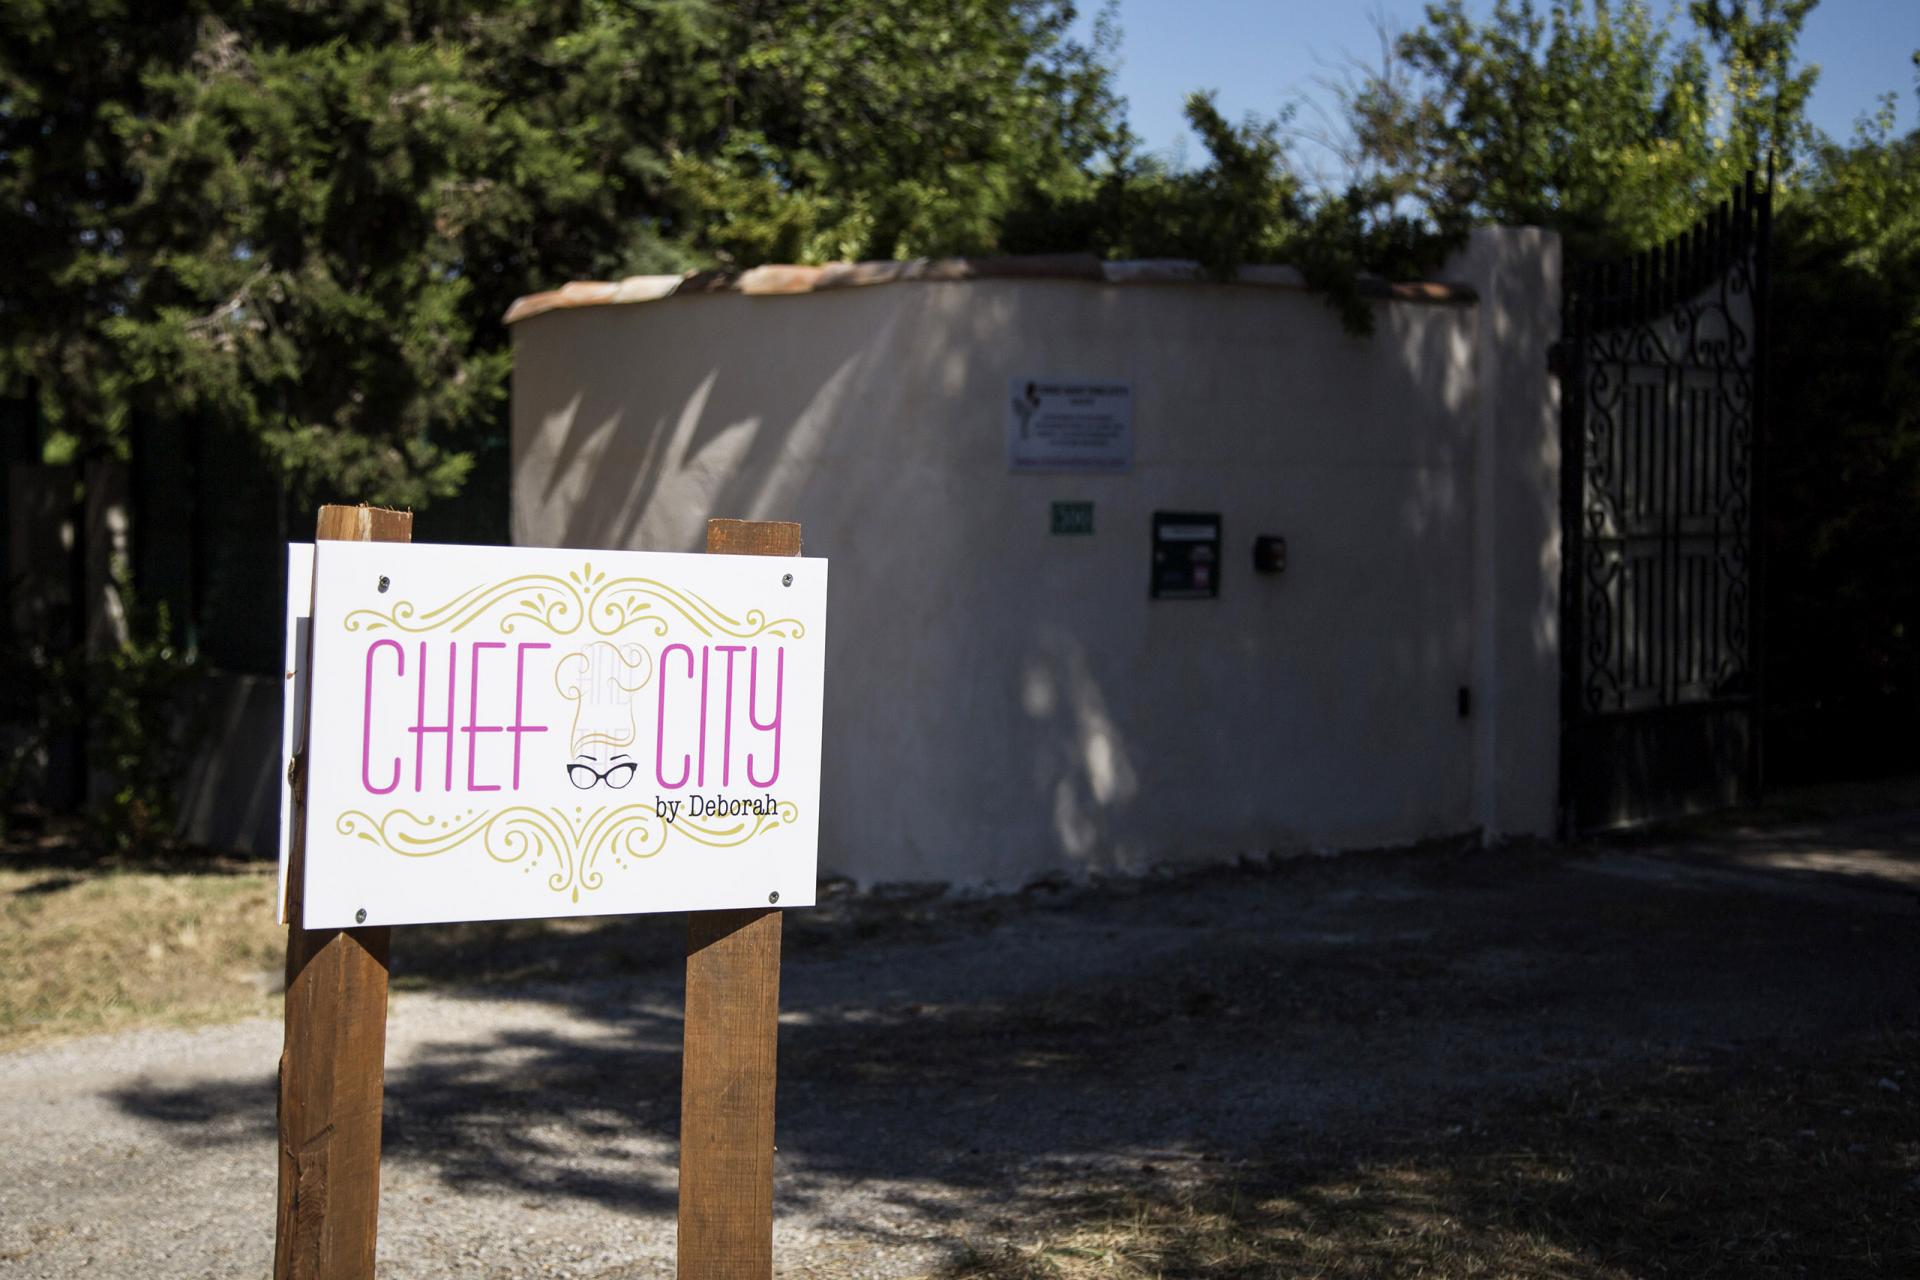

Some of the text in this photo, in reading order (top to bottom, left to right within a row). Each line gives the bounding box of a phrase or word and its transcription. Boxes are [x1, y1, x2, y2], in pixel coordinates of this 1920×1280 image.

[362, 639, 784, 794] CHEF CITY
[655, 793, 778, 824] by Deborah
